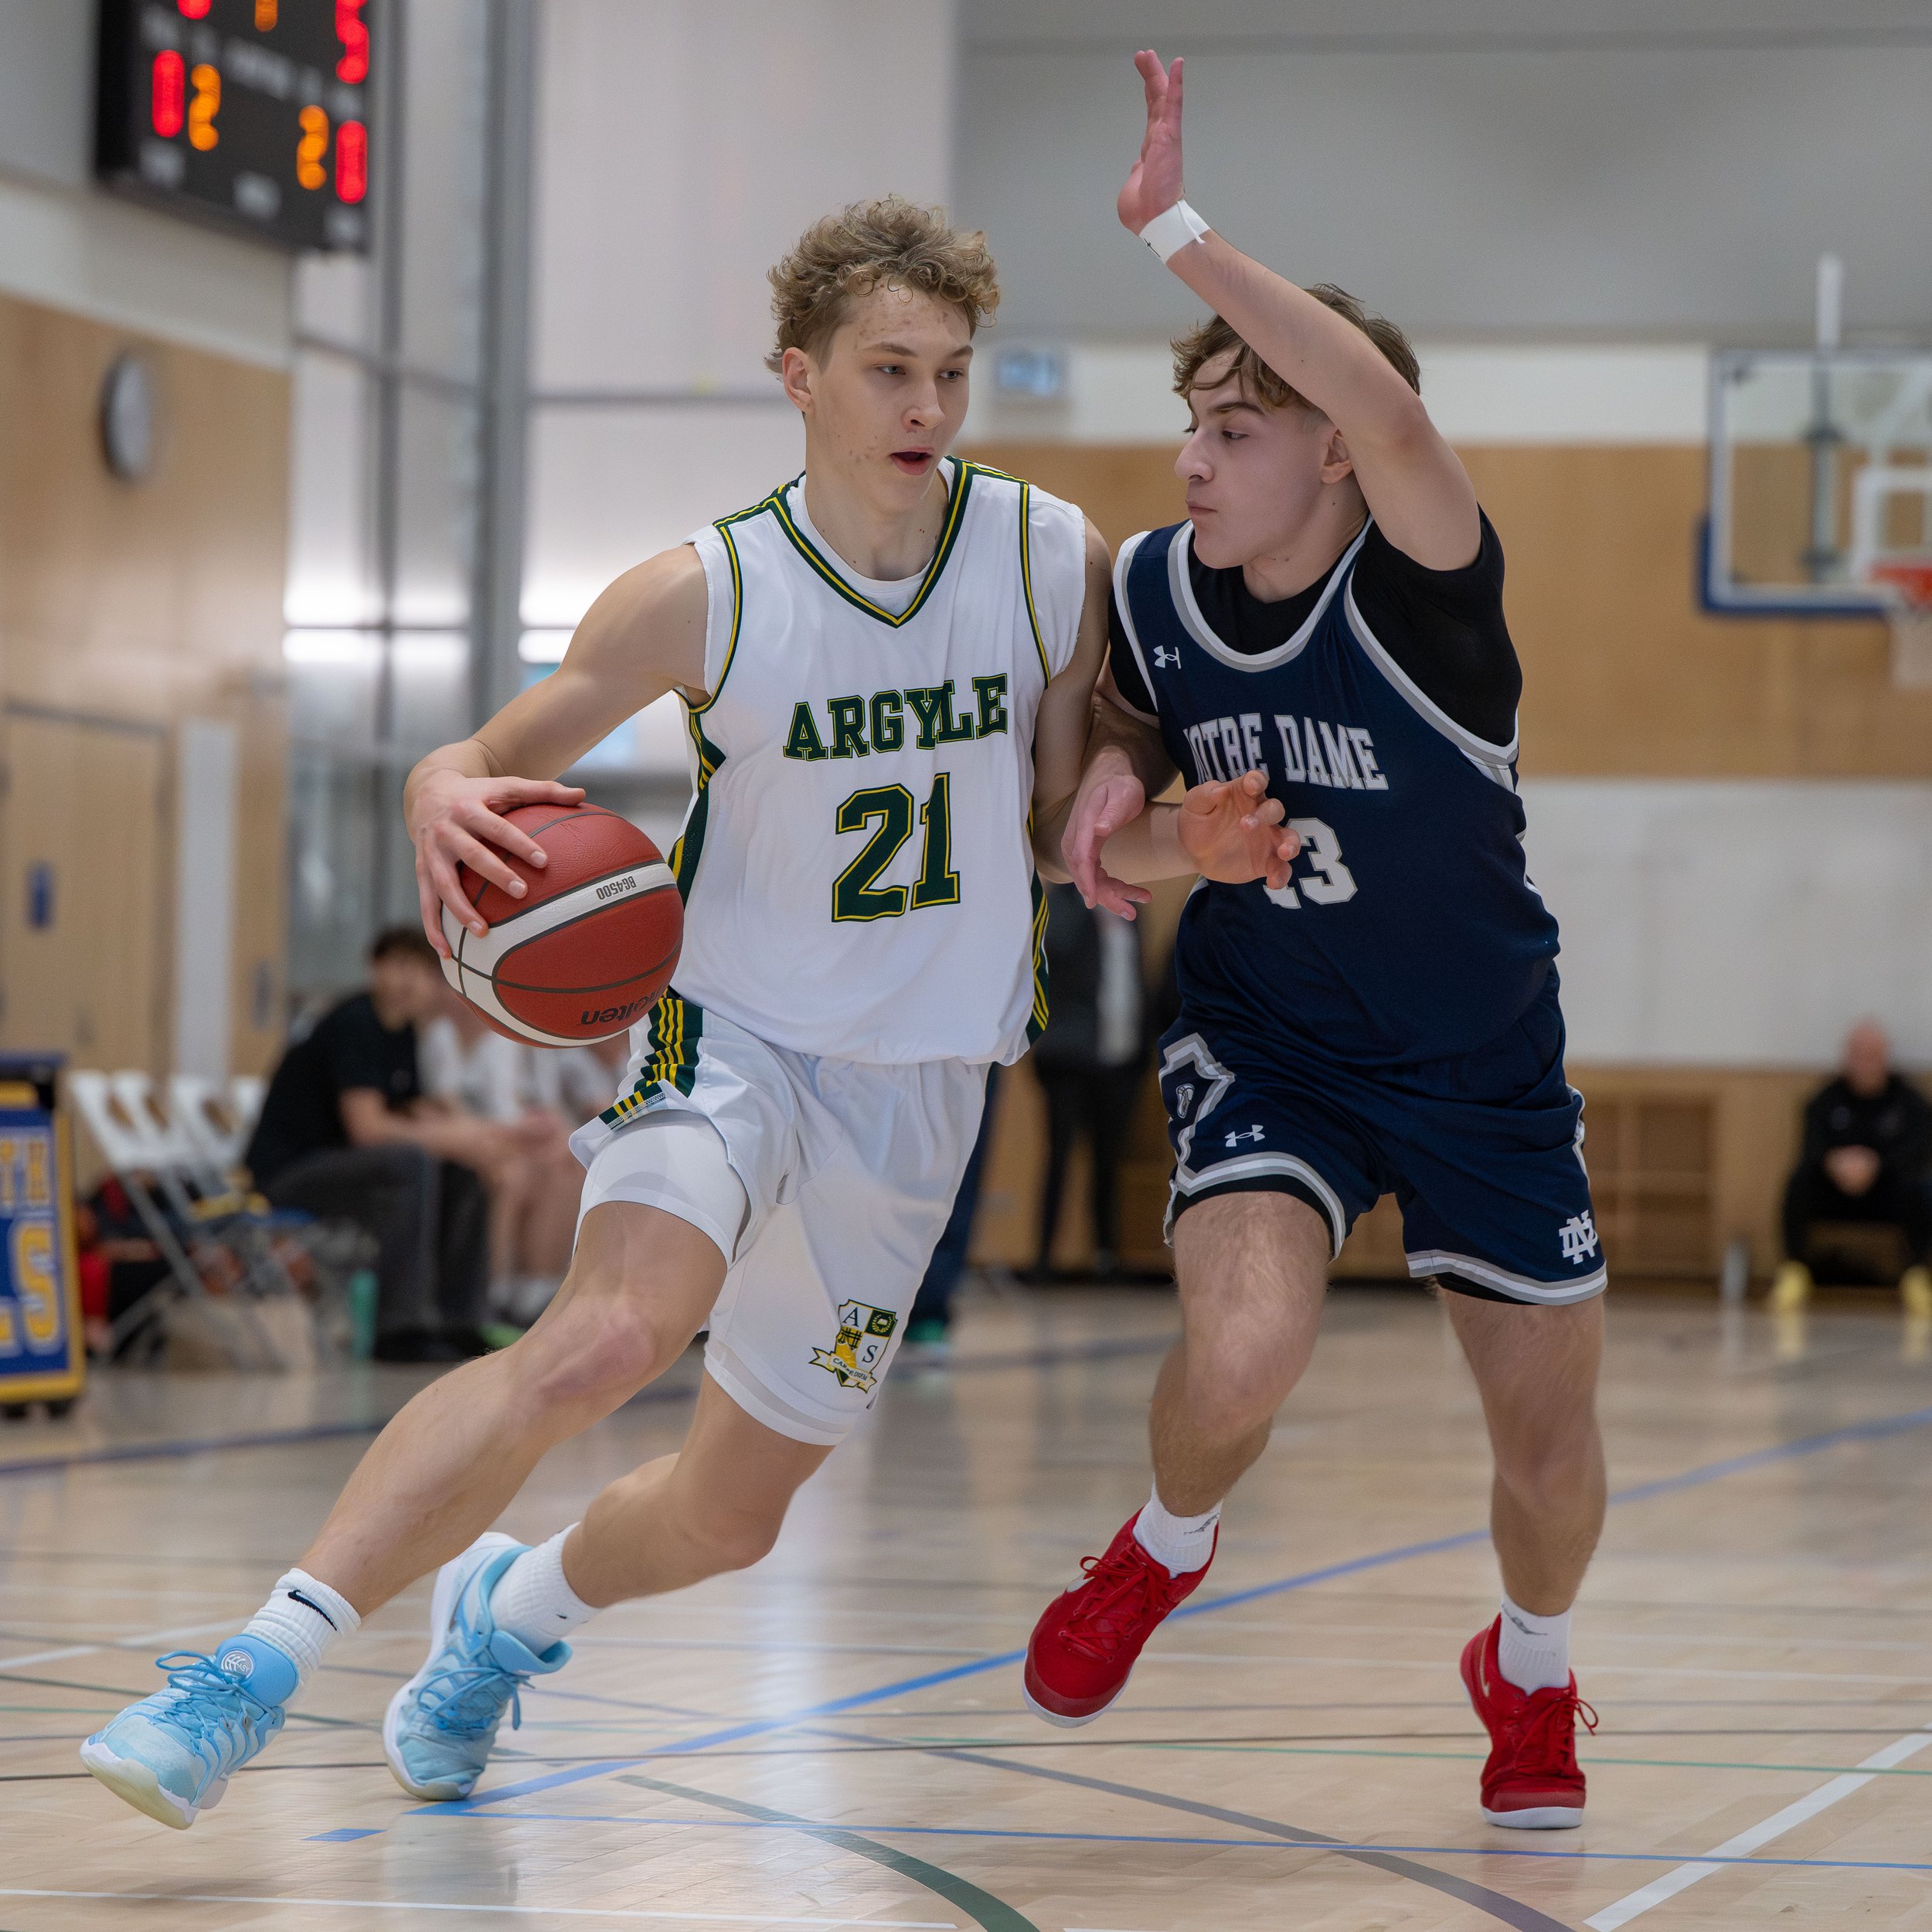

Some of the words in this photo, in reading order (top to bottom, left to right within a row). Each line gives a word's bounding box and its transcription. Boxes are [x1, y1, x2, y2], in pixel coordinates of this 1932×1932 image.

[782, 672, 1008, 762] ARGYLE
[1274, 714, 1389, 791] DAME
[831, 771, 961, 923] 21
[1262, 817, 1359, 910] 3
[595, 876, 637, 900] BG4500
[842, 1306, 860, 1328] A
[861, 1344, 879, 1363] S
